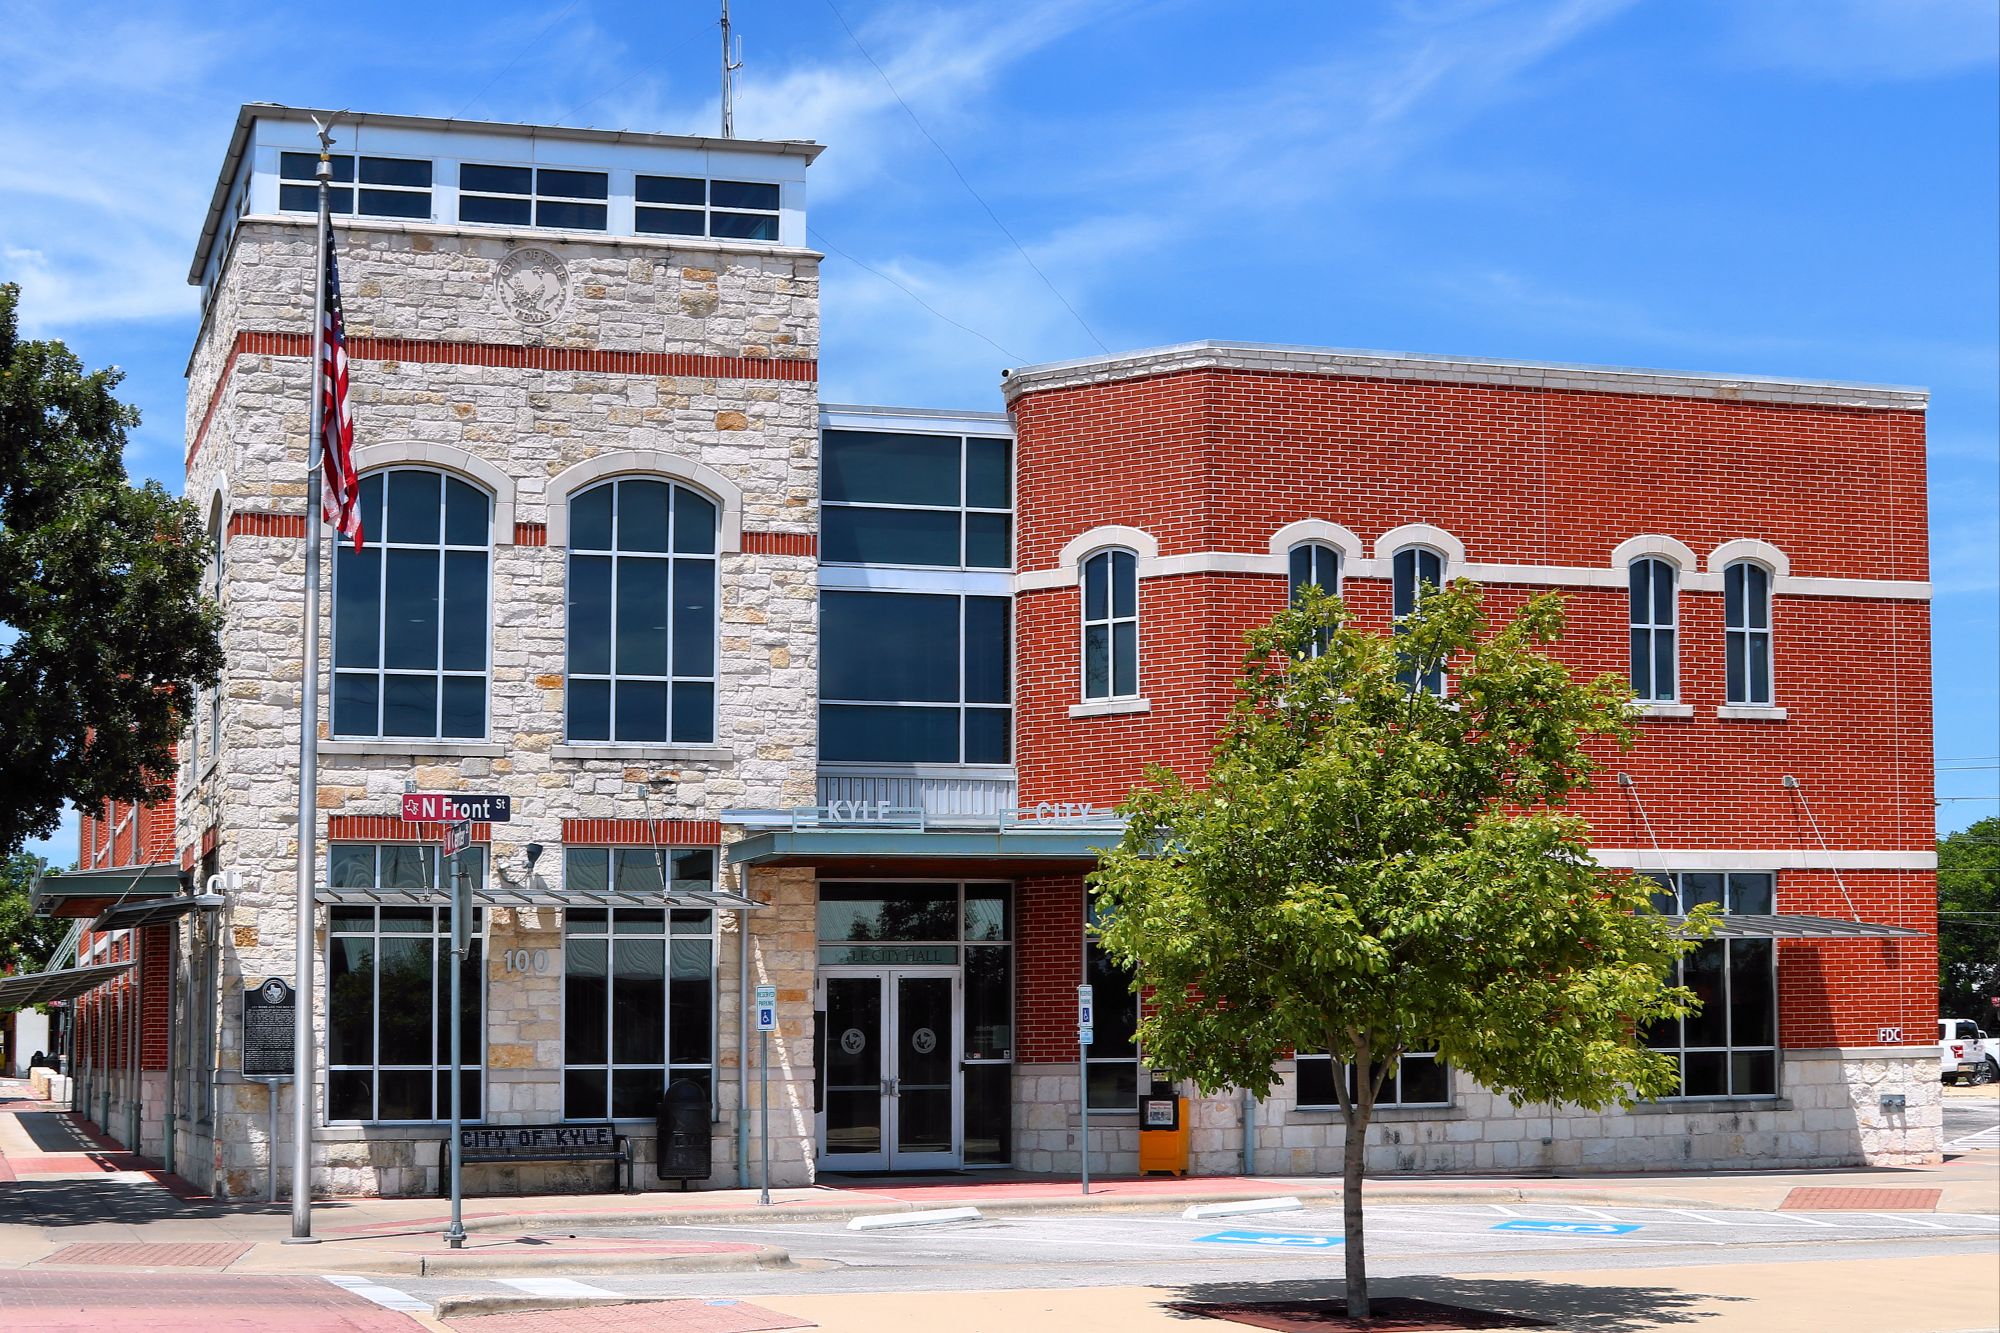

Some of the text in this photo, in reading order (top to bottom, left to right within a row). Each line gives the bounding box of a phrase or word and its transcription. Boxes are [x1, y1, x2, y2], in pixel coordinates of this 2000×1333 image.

[500, 250, 566, 281] CITY OF KYLE
[515, 308, 552, 322] TEXAS
[422, 797, 506, 819] N Front St
[828, 800, 1093, 825] KYLE CITY
[503, 949, 549, 973] 100
[904, 950, 942, 962] HALL
[1880, 1029, 1901, 1041] FDC
[461, 1128, 609, 1148] CITY OF KYLE
